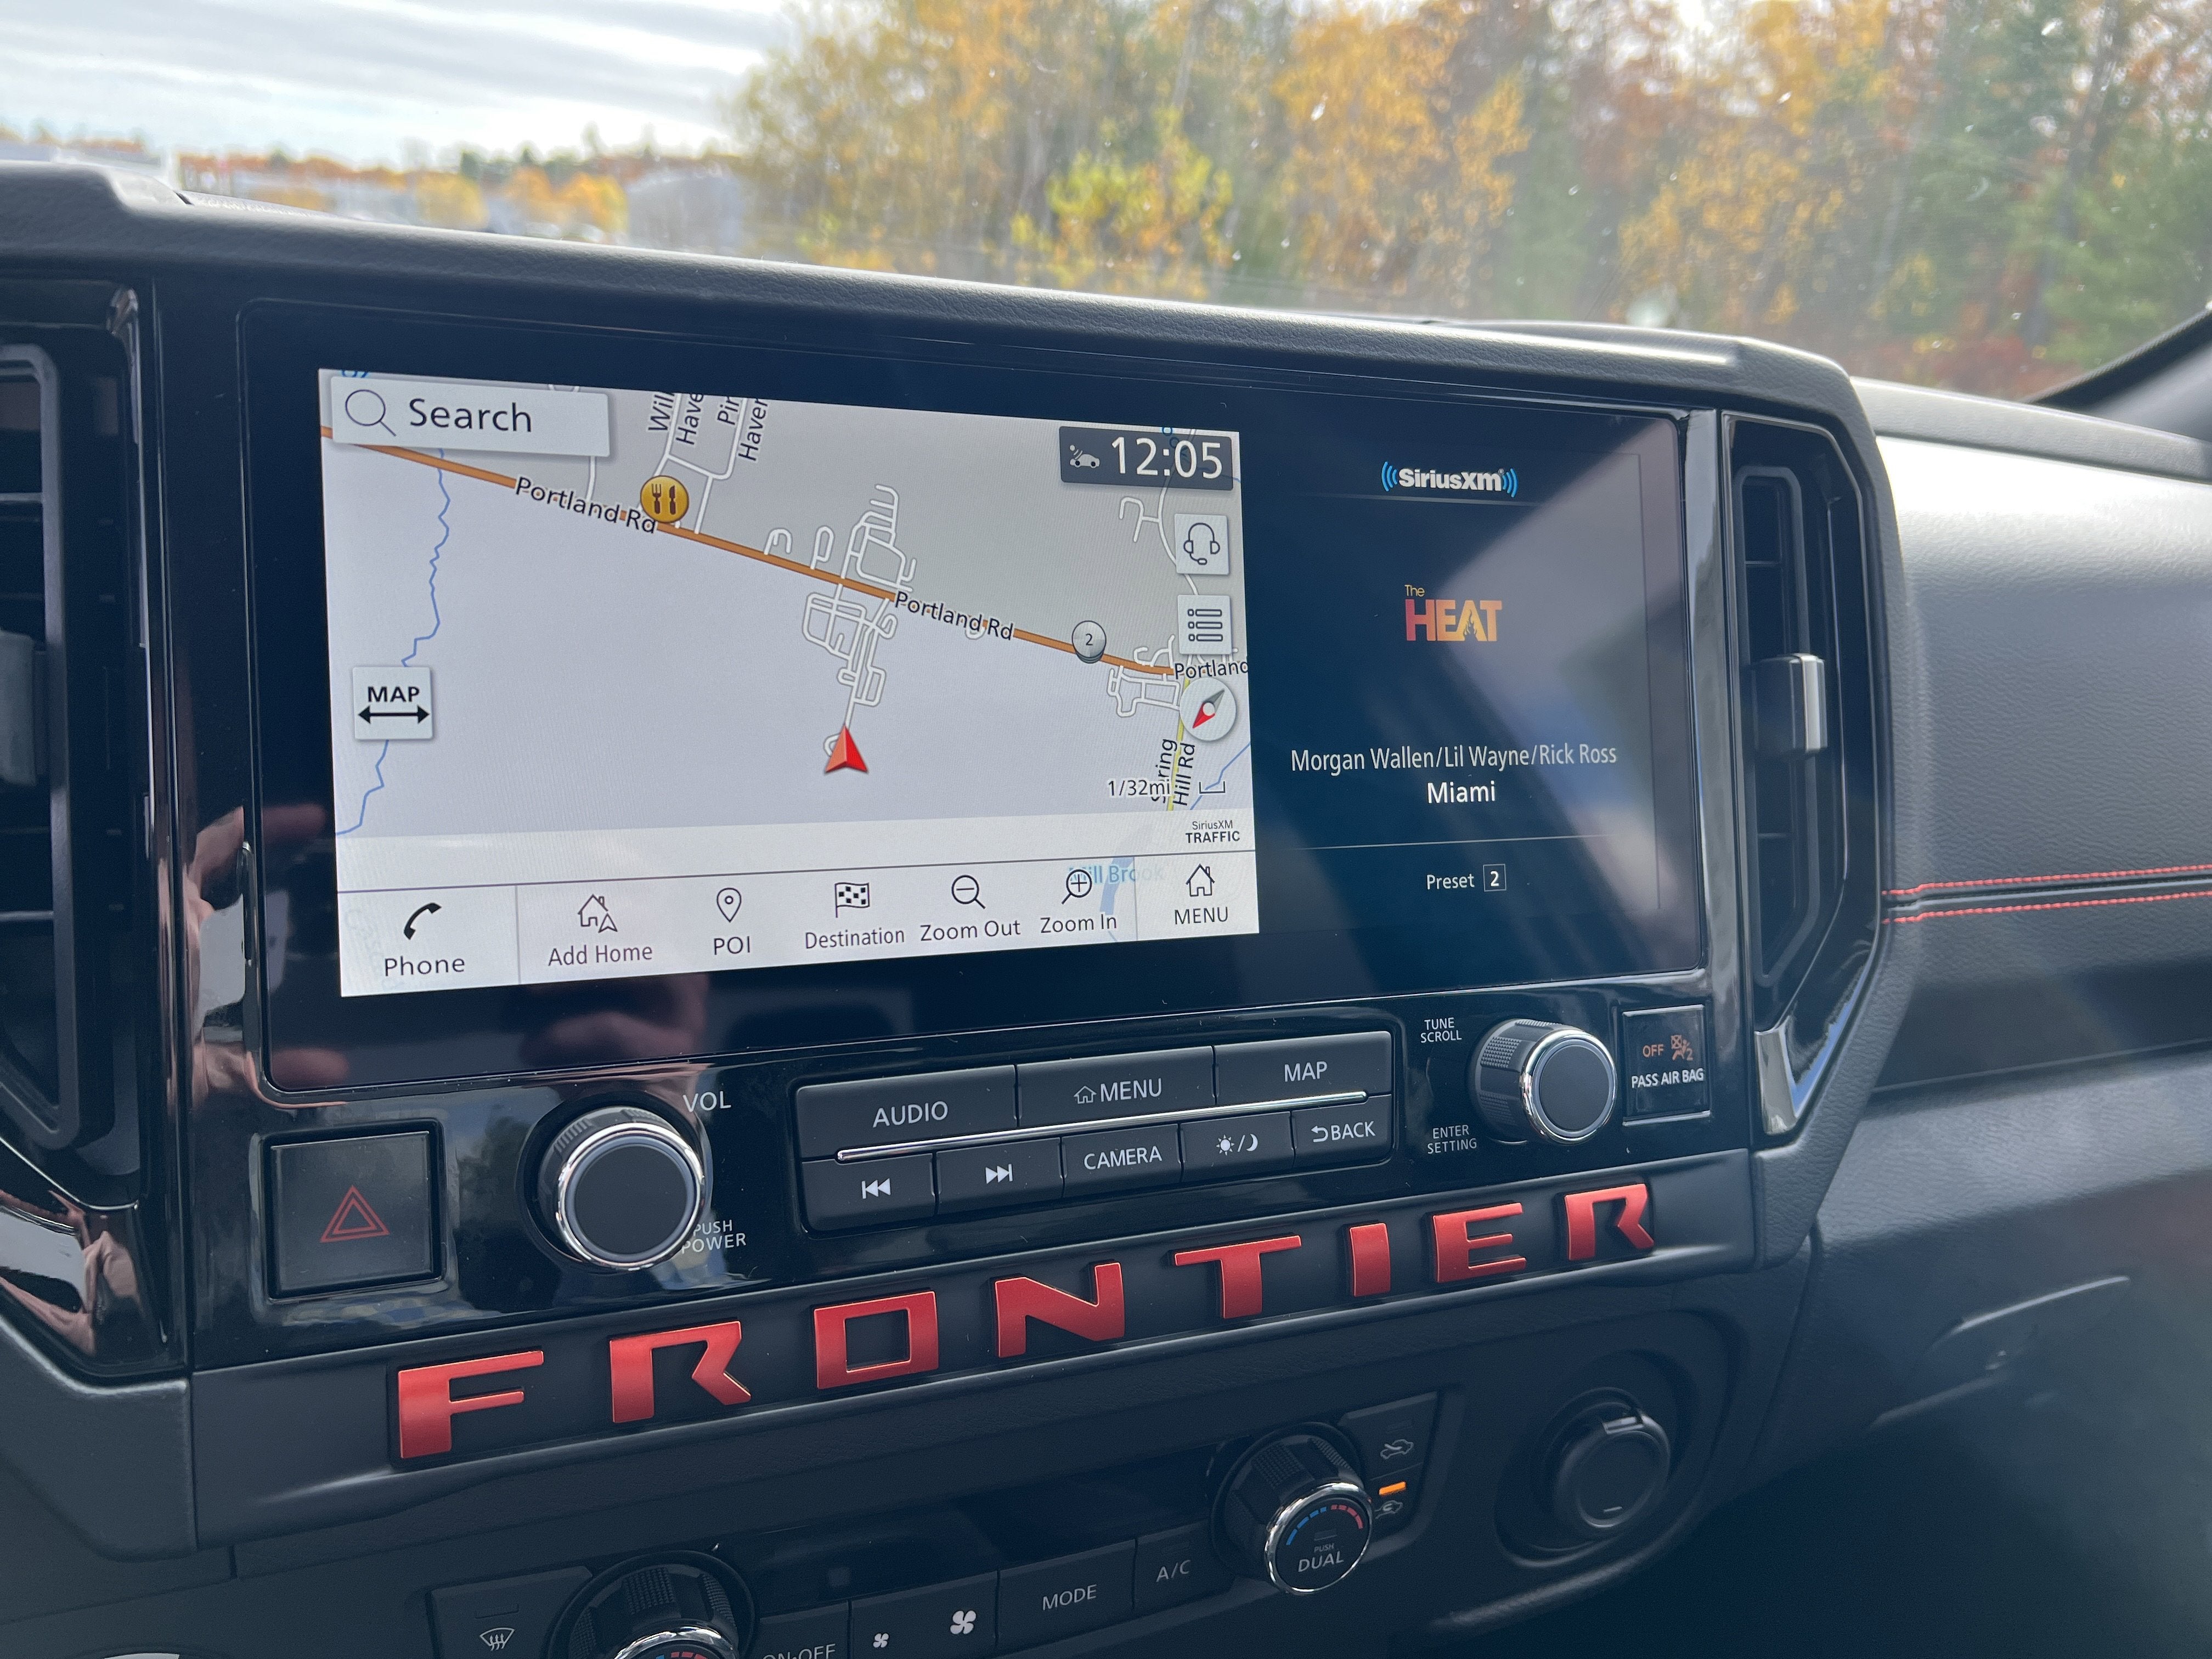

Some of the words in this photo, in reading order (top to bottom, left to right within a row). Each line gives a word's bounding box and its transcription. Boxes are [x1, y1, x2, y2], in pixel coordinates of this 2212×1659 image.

[409, 398, 532, 433] Search
[1111, 437, 1223, 479] 12:05
[515, 476, 620, 523] Portland
[1404, 584, 1425, 597] The
[895, 591, 982, 631] Portland
[987, 618, 1013, 640] Rd
[1405, 599, 1502, 641] HEAT
[1085, 634, 1093, 646] 2
[368, 686, 420, 702] MAP
[1178, 742, 1195, 769] Rd
[1291, 749, 1365, 776] Morgan
[1370, 745, 1464, 769] Wallen/Lil
[1469, 743, 1575, 772] Wayne/Rick
[1579, 743, 1617, 765] Ross
[1108, 778, 1170, 796] 1/32mi
[1172, 774, 1192, 806] Hill
[1427, 780, 1496, 804] Miami
[1192, 820, 1234, 831] SiriusXM
[1185, 831, 1240, 844] TRAFFIC
[1426, 873, 1475, 890] Preset
[1489, 870, 1500, 887] 2
[1040, 917, 1094, 933] Zoom
[1101, 914, 1117, 929] In
[1175, 906, 1229, 926] MENU
[805, 927, 905, 949] Destination
[920, 924, 978, 942] Zoom
[984, 920, 1021, 938] Out
[548, 945, 588, 967] Add
[596, 944, 653, 963] Home
[714, 936, 751, 955] POI
[385, 955, 465, 977] Phone
[1424, 1017, 1454, 1031] TUNE
[1420, 1030, 1462, 1043] SCROLL
[1643, 1044, 1664, 1058] OFF
[1284, 1060, 1328, 1082] MAP
[1631, 1073, 1659, 1089] PASS
[1661, 1070, 1680, 1086] AIR
[1681, 1068, 1705, 1084] BAG
[682, 1090, 732, 1113] VOL
[1099, 1078, 1163, 1103] MENU
[872, 1101, 949, 1128] AUDIO
[1330, 1121, 1376, 1141] BACK
[1432, 1124, 1470, 1139] ENTER
[1427, 1137, 1477, 1154] SETTING
[1084, 1146, 1163, 1170] CAMERA
[693, 1219, 733, 1237] PUSH
[681, 1232, 747, 1255] POWER
[397, 1181, 1656, 1460] FRONTIER
[1313, 1543, 1335, 1553] PUSH
[1156, 1560, 1192, 1583] A/C
[1297, 1550, 1344, 1573] DUAL
[1042, 1584, 1097, 1611] MODE
